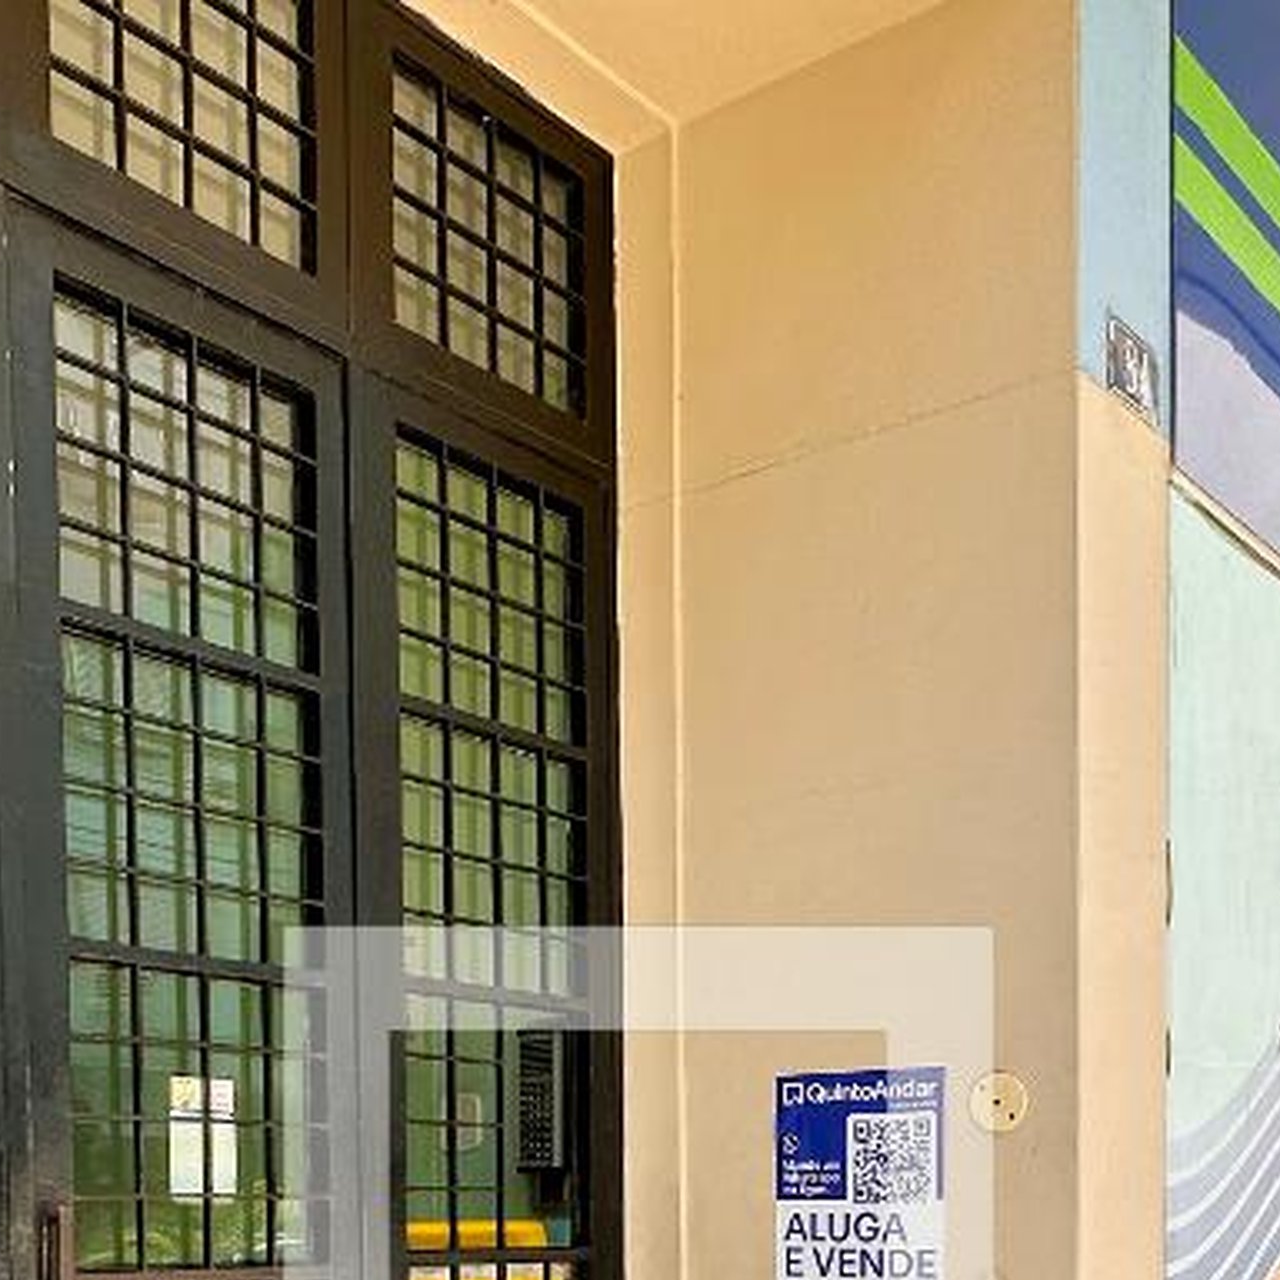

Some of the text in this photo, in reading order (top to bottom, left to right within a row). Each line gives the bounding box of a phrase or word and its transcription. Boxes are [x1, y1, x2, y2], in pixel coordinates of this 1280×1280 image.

[806, 1079, 938, 1105] QuintoAndar
[784, 1212, 908, 1243] ALUGA
[786, 1246, 938, 1280] E VENDE
